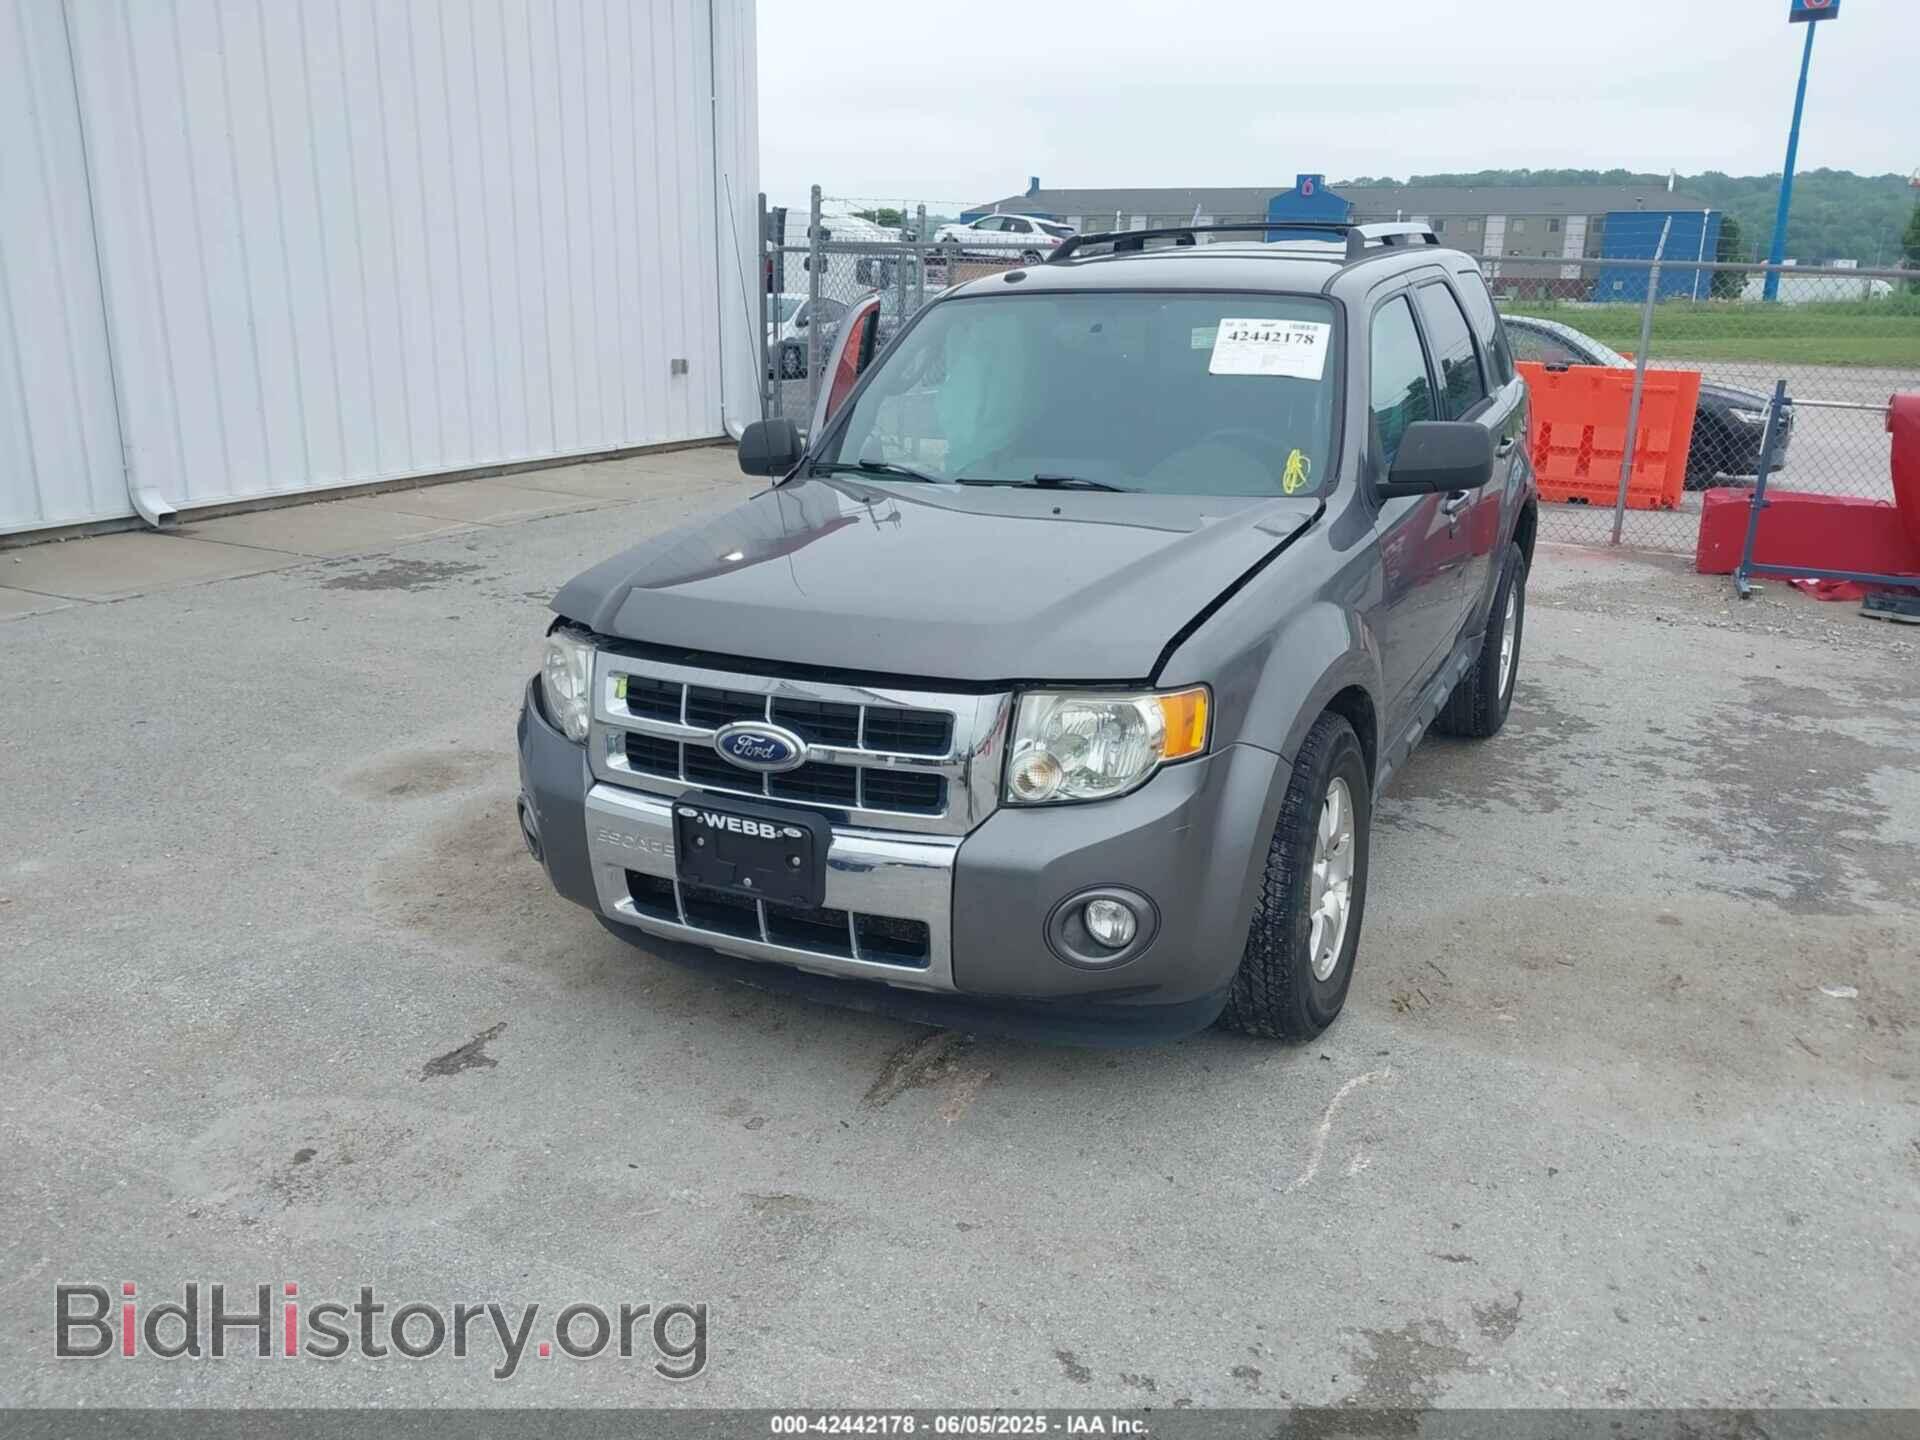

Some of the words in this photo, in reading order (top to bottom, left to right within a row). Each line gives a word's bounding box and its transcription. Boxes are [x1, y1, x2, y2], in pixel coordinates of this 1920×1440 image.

[1302, 177, 1313, 195] 6
[1227, 330, 1315, 345] 42442178
[733, 734, 776, 759] Ford
[703, 812, 777, 839] WEBB
